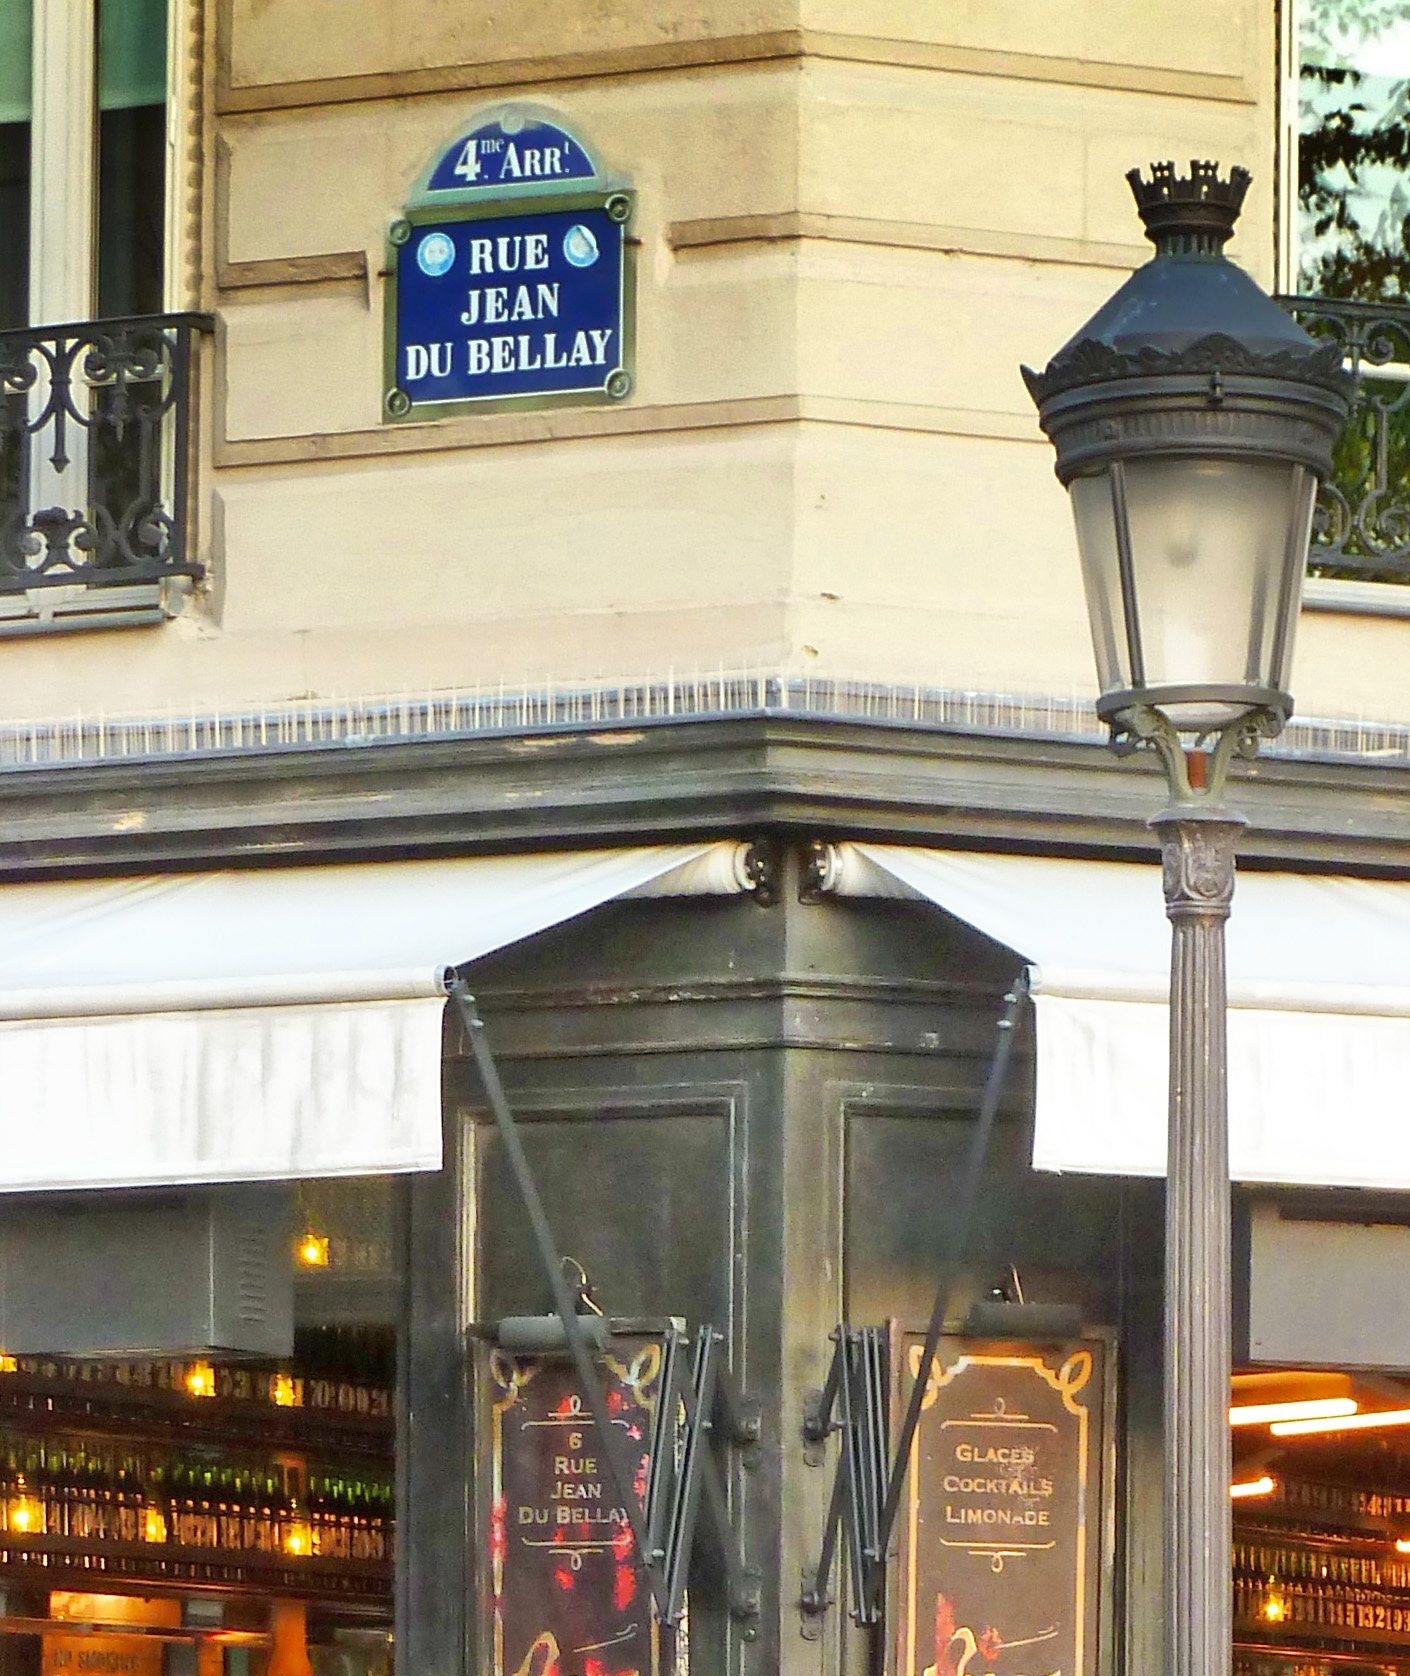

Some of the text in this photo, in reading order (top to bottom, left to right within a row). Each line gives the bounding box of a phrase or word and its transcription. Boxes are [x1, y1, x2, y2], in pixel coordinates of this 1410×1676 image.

[468, 234, 550, 275] RUE
[460, 282, 561, 326] JEAN
[405, 328, 613, 381] DU BELLAY
[567, 1432, 583, 1450] 6
[955, 1444, 1035, 1464] GLACES
[943, 1475, 1054, 1496] COCKTAILS
